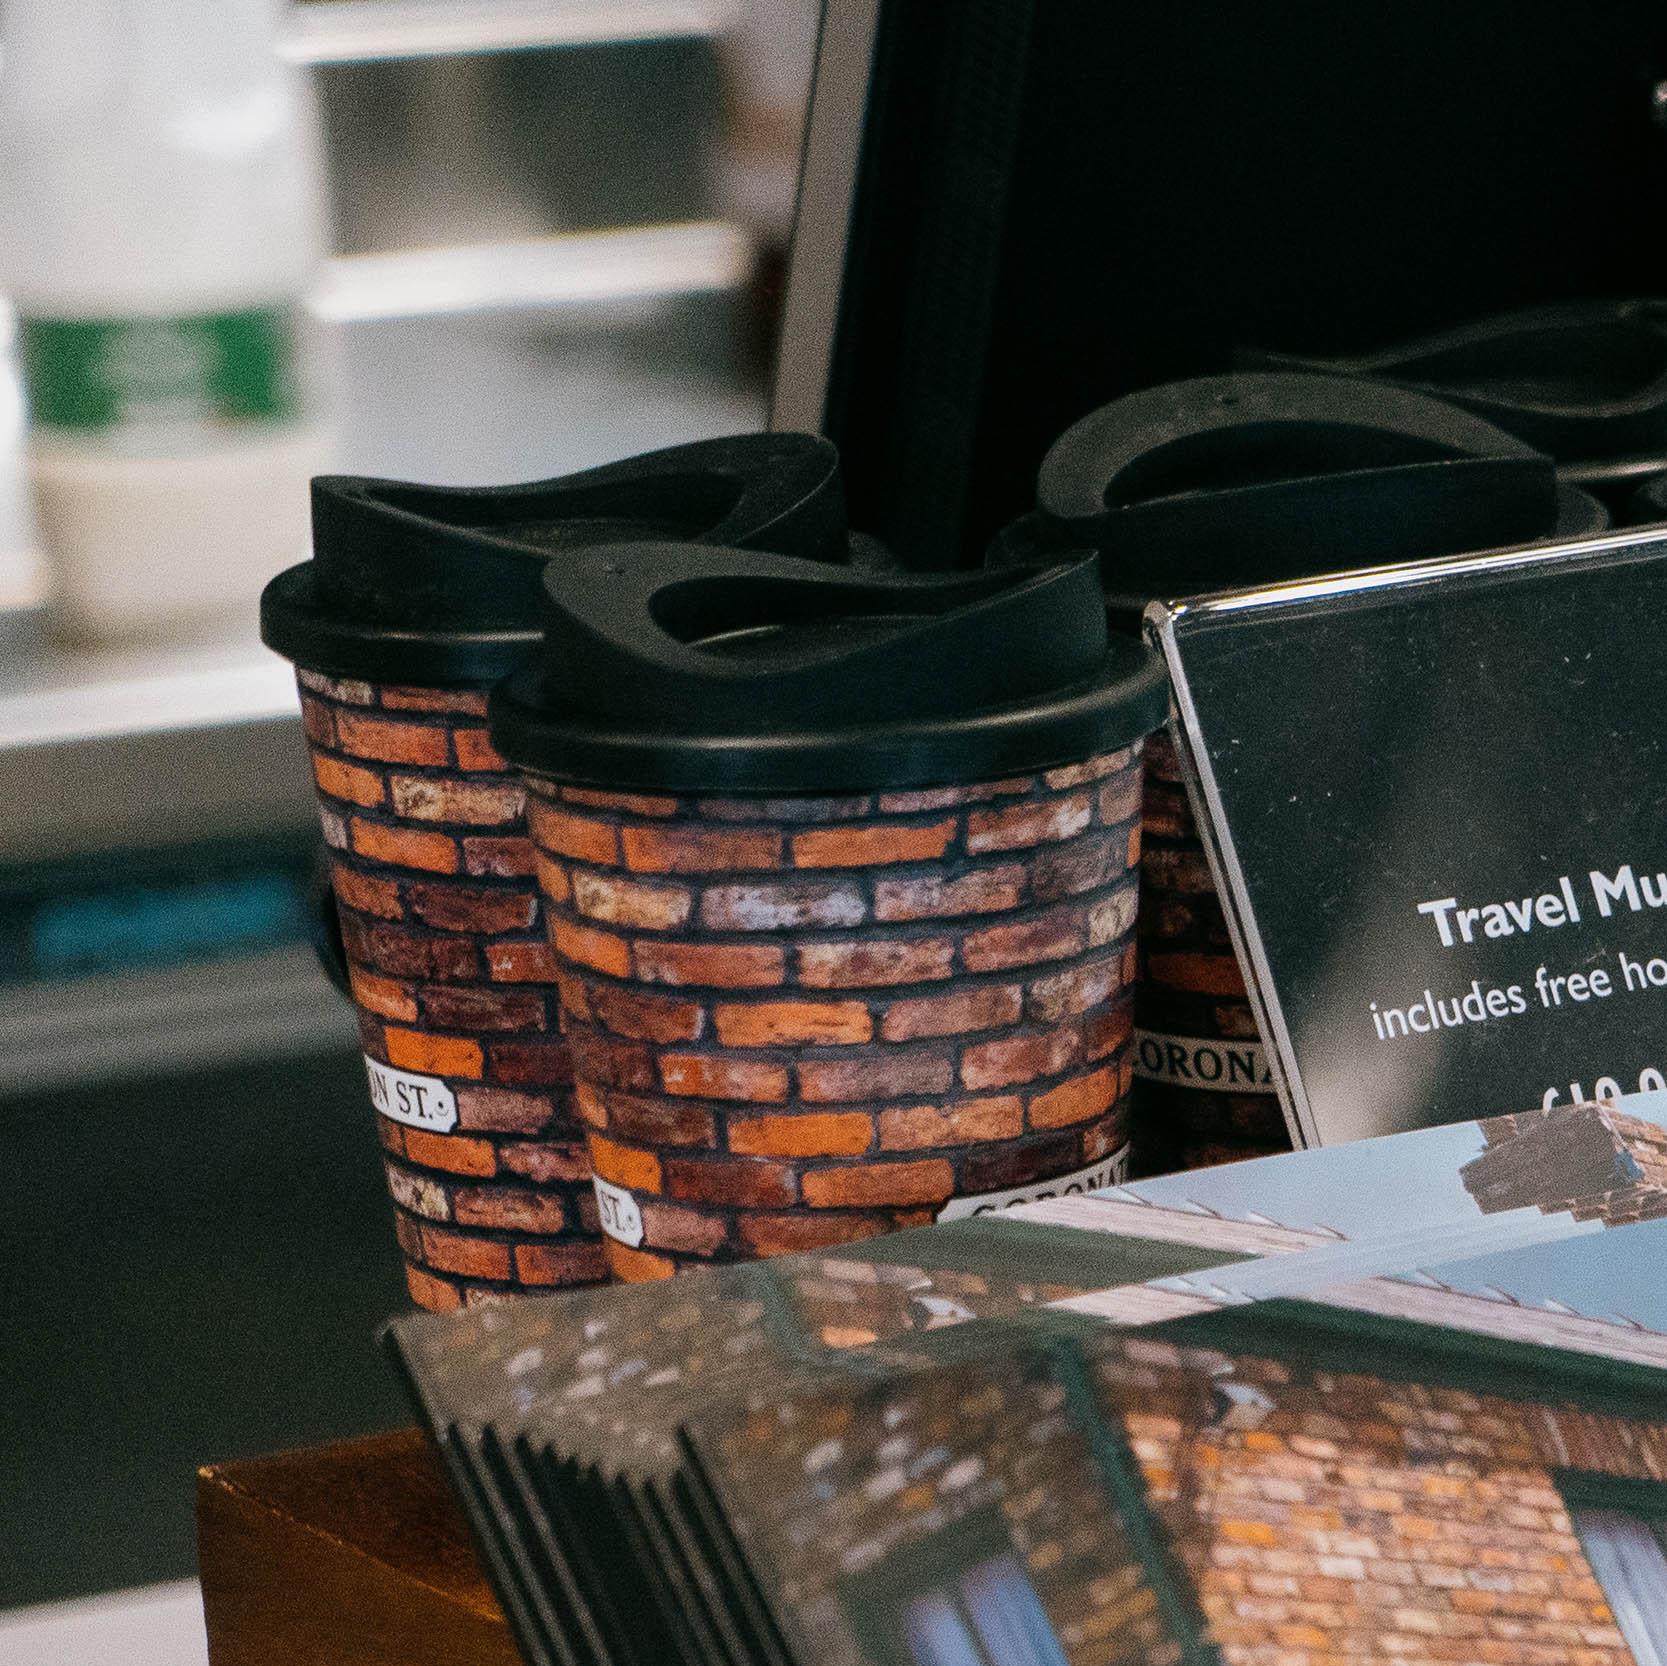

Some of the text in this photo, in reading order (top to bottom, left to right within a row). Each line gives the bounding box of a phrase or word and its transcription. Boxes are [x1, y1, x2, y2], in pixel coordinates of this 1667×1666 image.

[1417, 877, 1580, 947] Travel
[1369, 980, 1527, 1041] includes
[1535, 965, 1612, 1008] free
[396, 1080, 434, 1120] ST.
